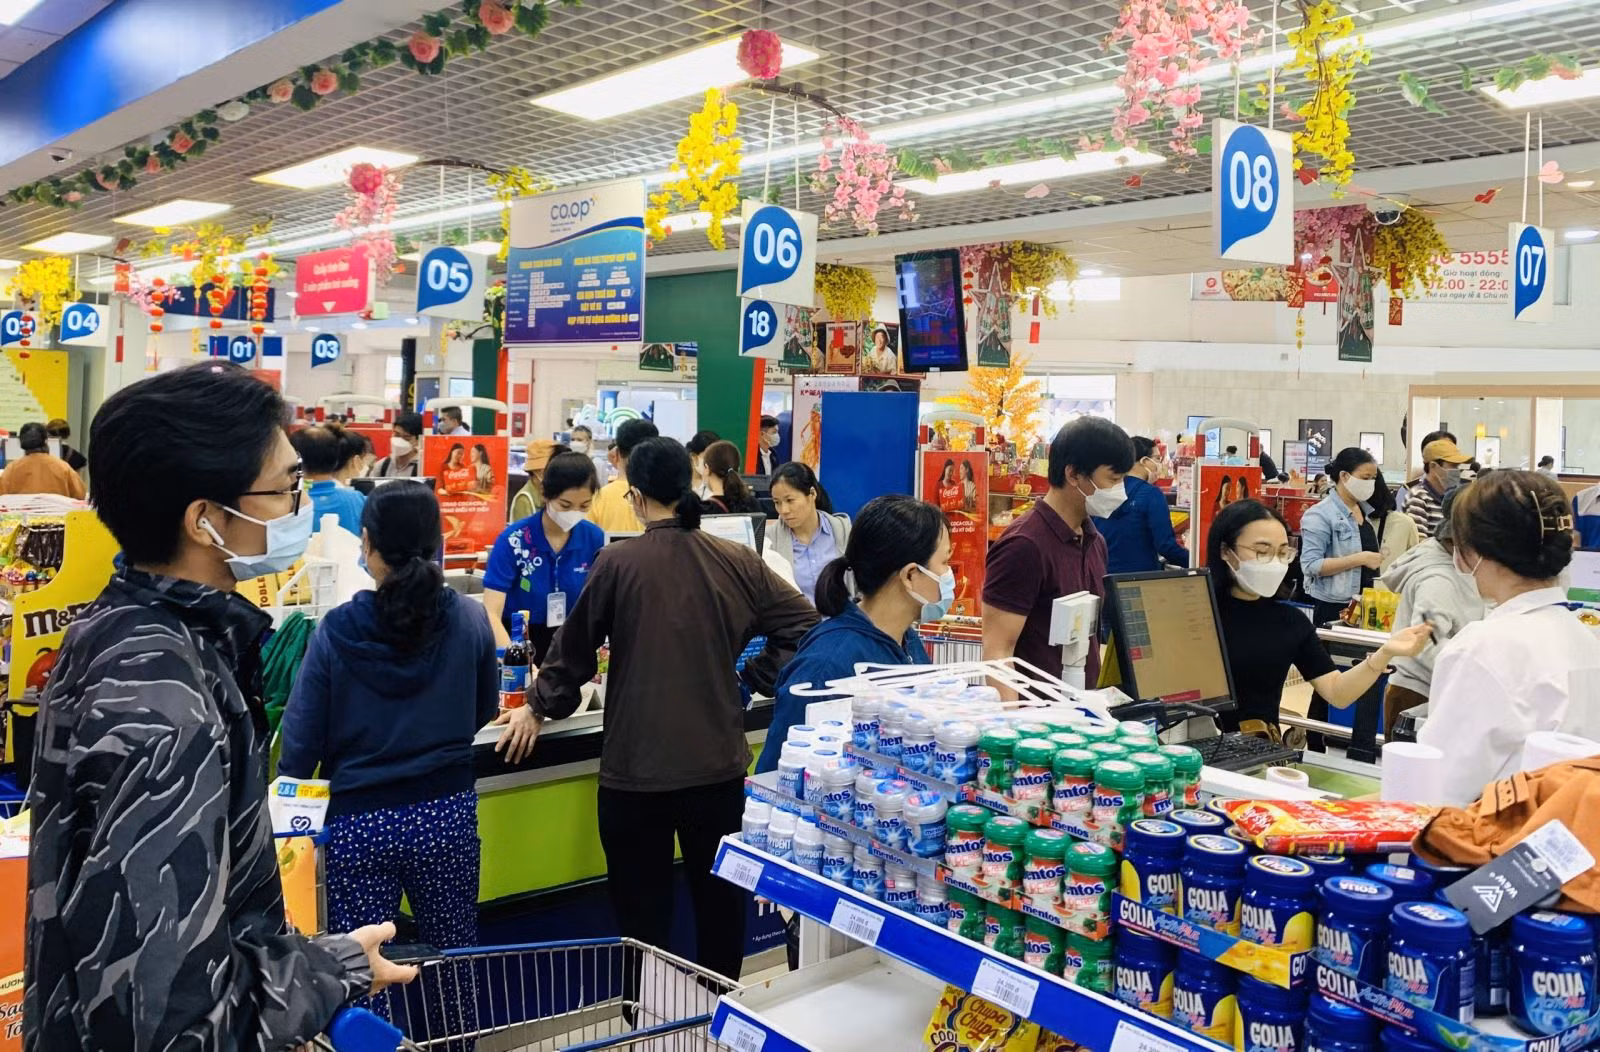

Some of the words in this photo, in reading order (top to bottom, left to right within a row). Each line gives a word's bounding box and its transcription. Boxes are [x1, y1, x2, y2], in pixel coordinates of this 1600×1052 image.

[1230, 151, 1274, 212] 08
[753, 223, 798, 268] 06
[427, 259, 469, 293] 05
[1519, 245, 1544, 286] 07
[67, 311, 98, 333] 04
[748, 309, 770, 337] 18
[232, 341, 252, 358] 01
[315, 340, 339, 358] 03
[975, 796, 1009, 813] mentos
[820, 821, 848, 837] mentos
[1051, 820, 1090, 838] mentos
[873, 847, 904, 865] mentos
[944, 875, 978, 894] mentos
[1187, 886, 1229, 912] GOLIA
[1022, 904, 1061, 925] mentos
[1120, 899, 1156, 931] GOLIA
[1241, 903, 1277, 933] GOLIA
[1317, 923, 1353, 956] GOLIA
[1116, 966, 1153, 992] GOLIA
[1388, 951, 1429, 984] GOLIA
[1316, 965, 1361, 1003] GOLIA
[1532, 970, 1586, 998] GOLIA
[969, 998, 1009, 1025] Chupa
[1174, 986, 1206, 1016] GOLIA
[959, 1012, 1000, 1039] Chups
[1250, 1021, 1295, 1048] GOLIA
